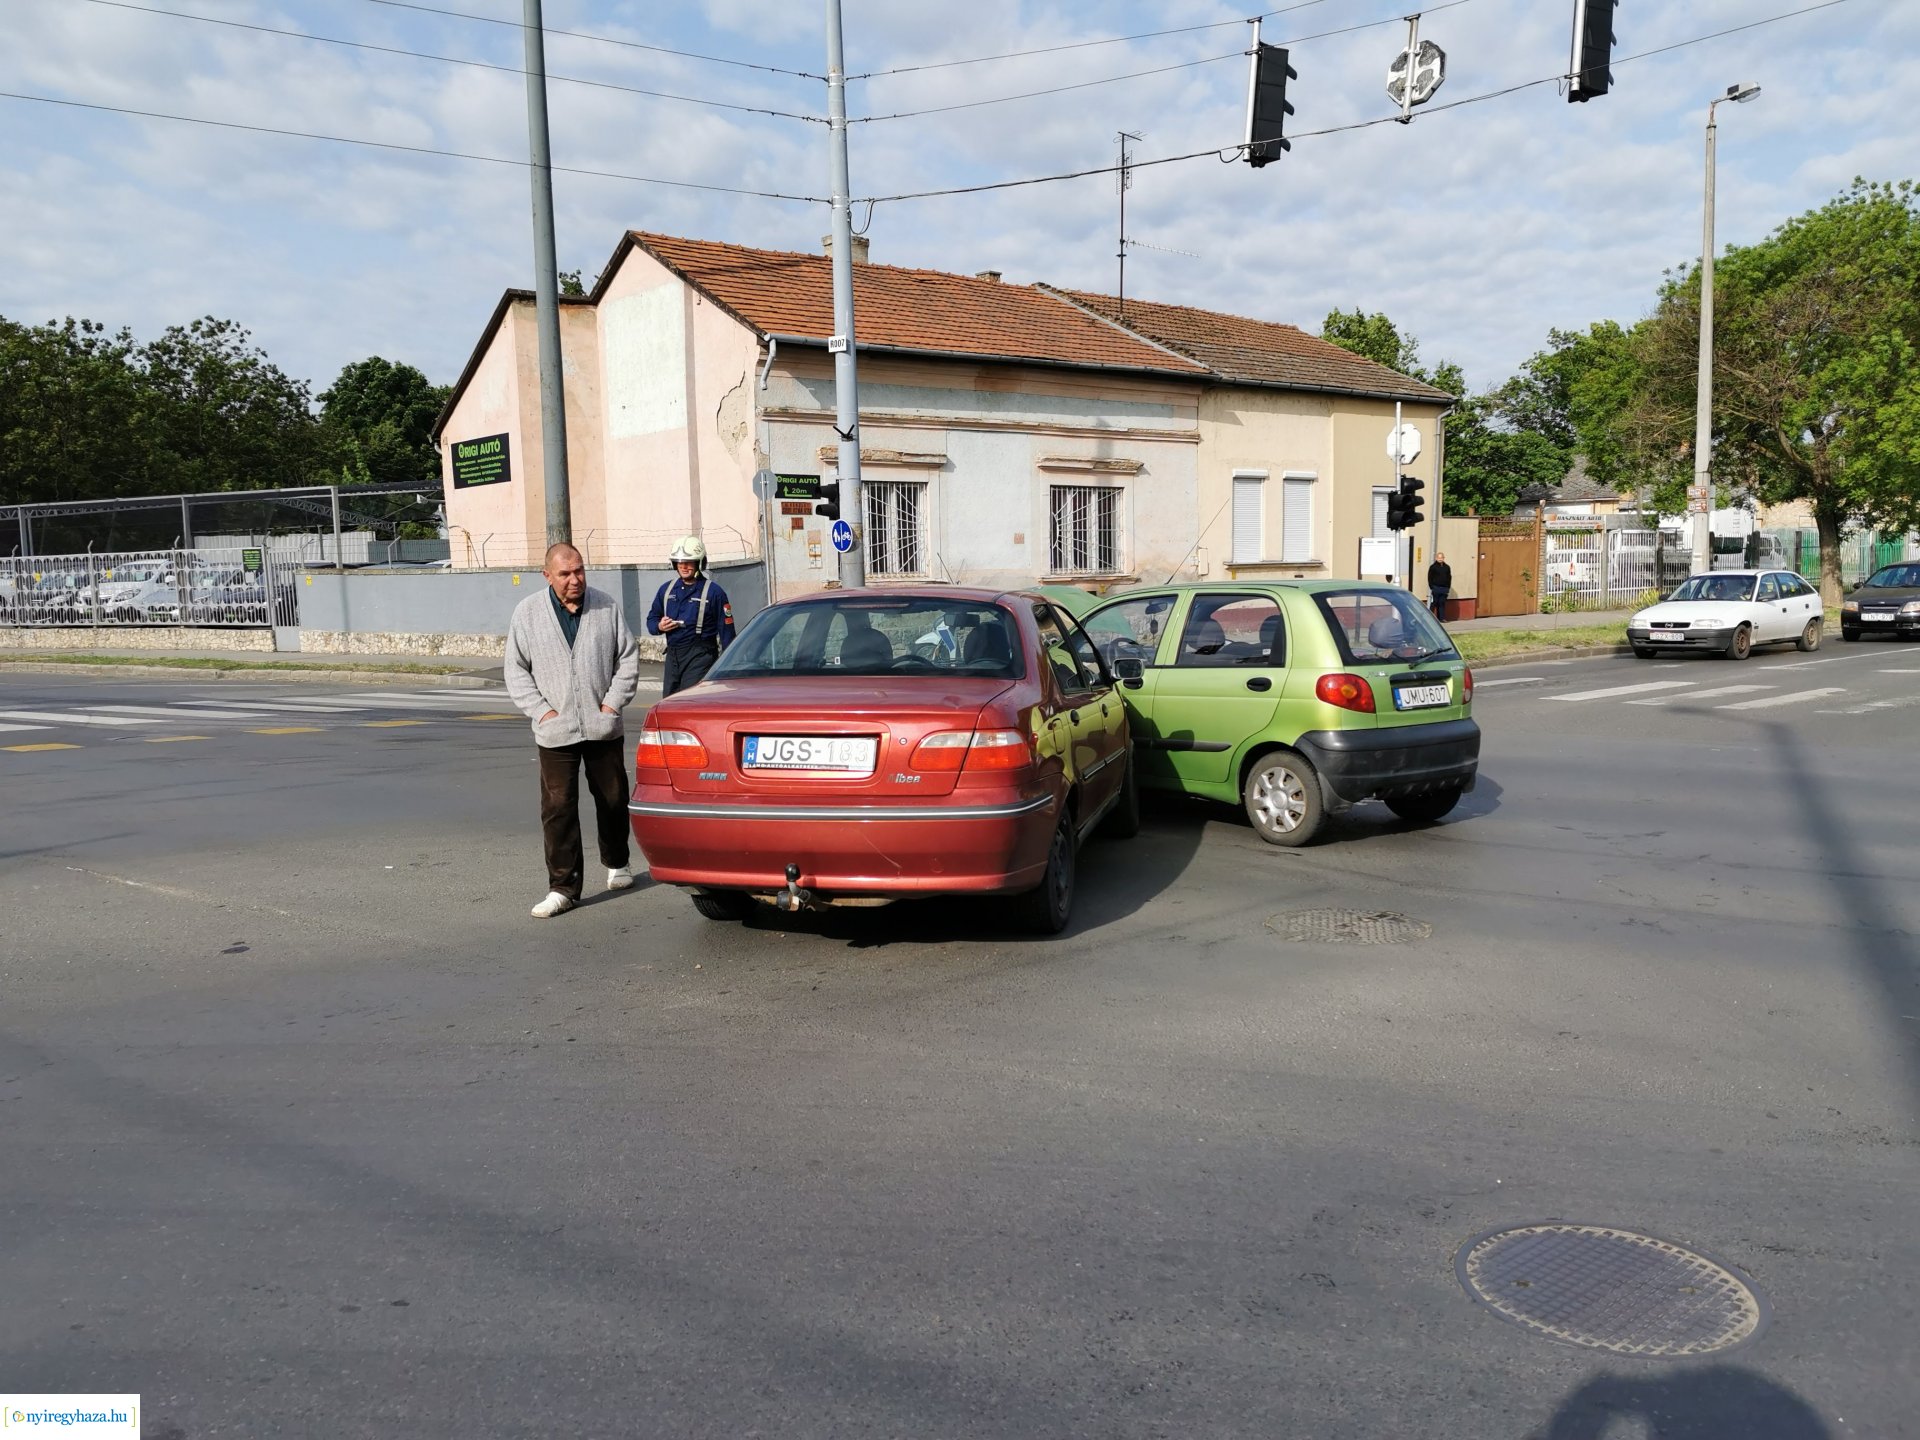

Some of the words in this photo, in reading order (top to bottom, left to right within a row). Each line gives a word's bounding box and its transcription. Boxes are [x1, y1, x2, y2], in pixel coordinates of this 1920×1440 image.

[458, 443, 478, 458] ORIGI
[480, 438, 501, 455] AUTÓ
[1404, 687, 1446, 705] JMU-607
[762, 739, 869, 763] JGS-183
